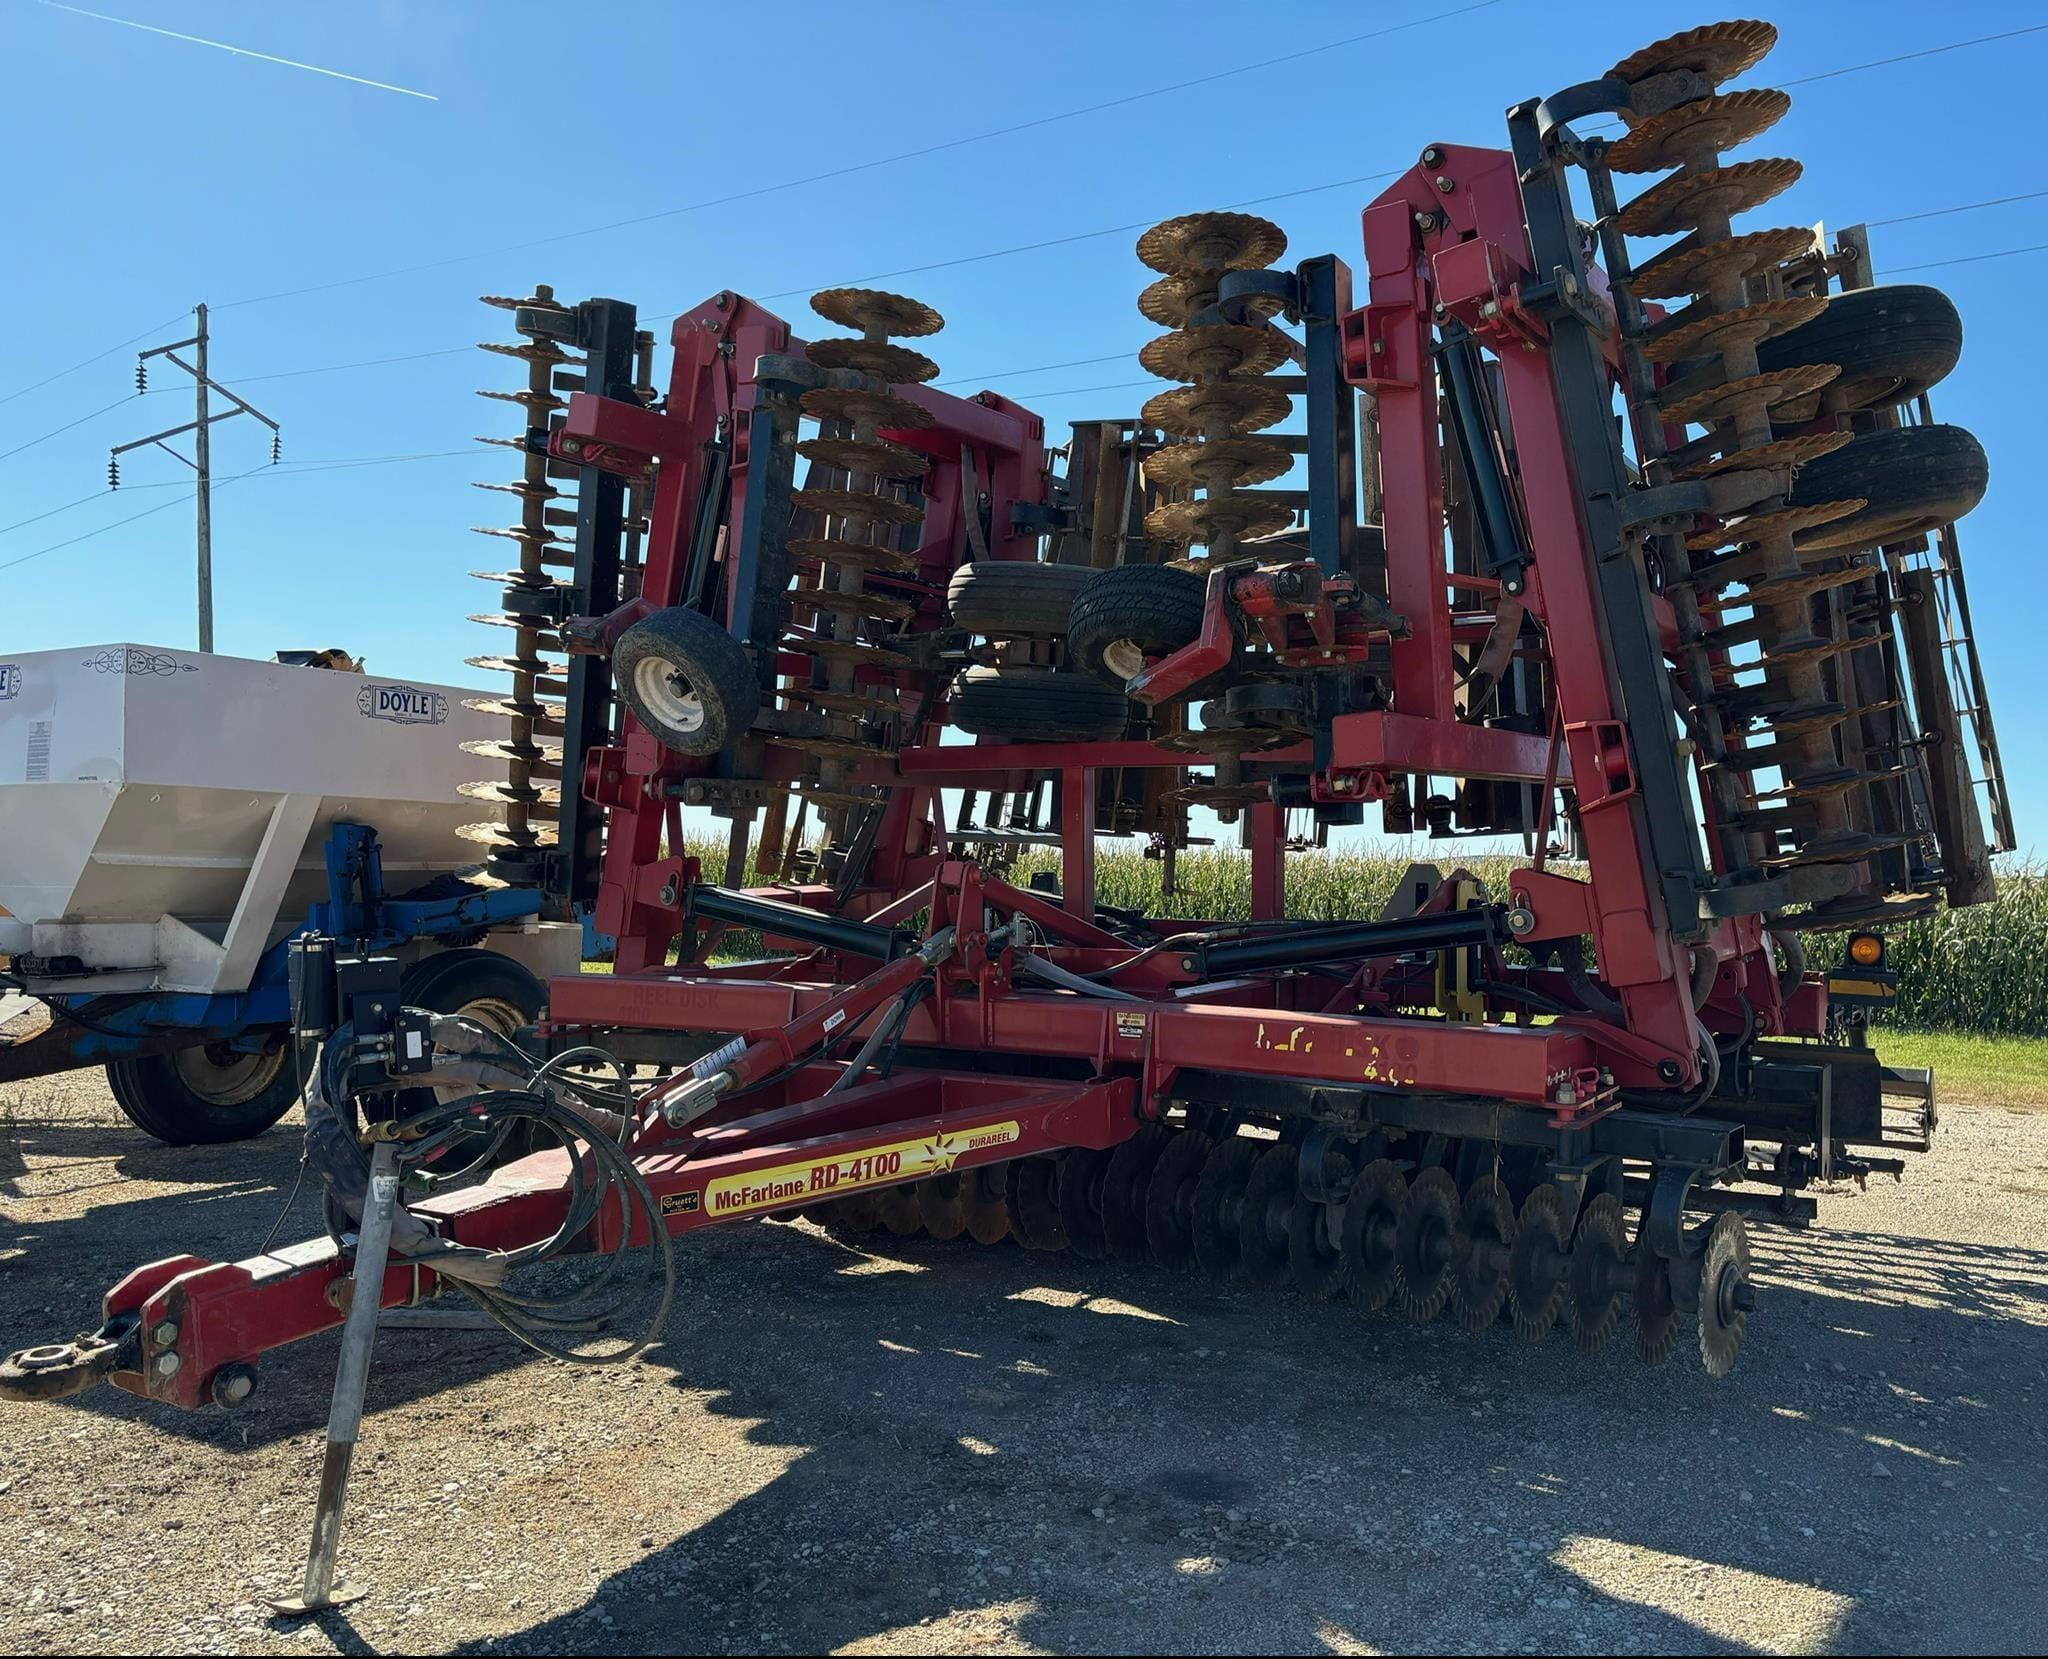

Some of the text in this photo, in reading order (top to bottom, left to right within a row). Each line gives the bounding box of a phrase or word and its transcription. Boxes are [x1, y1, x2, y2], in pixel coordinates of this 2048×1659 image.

[380, 691, 429, 715] DOYLE
[969, 1132, 1012, 1148] DURAREEL
[715, 1151, 901, 1210] McFarlane RD-4100
